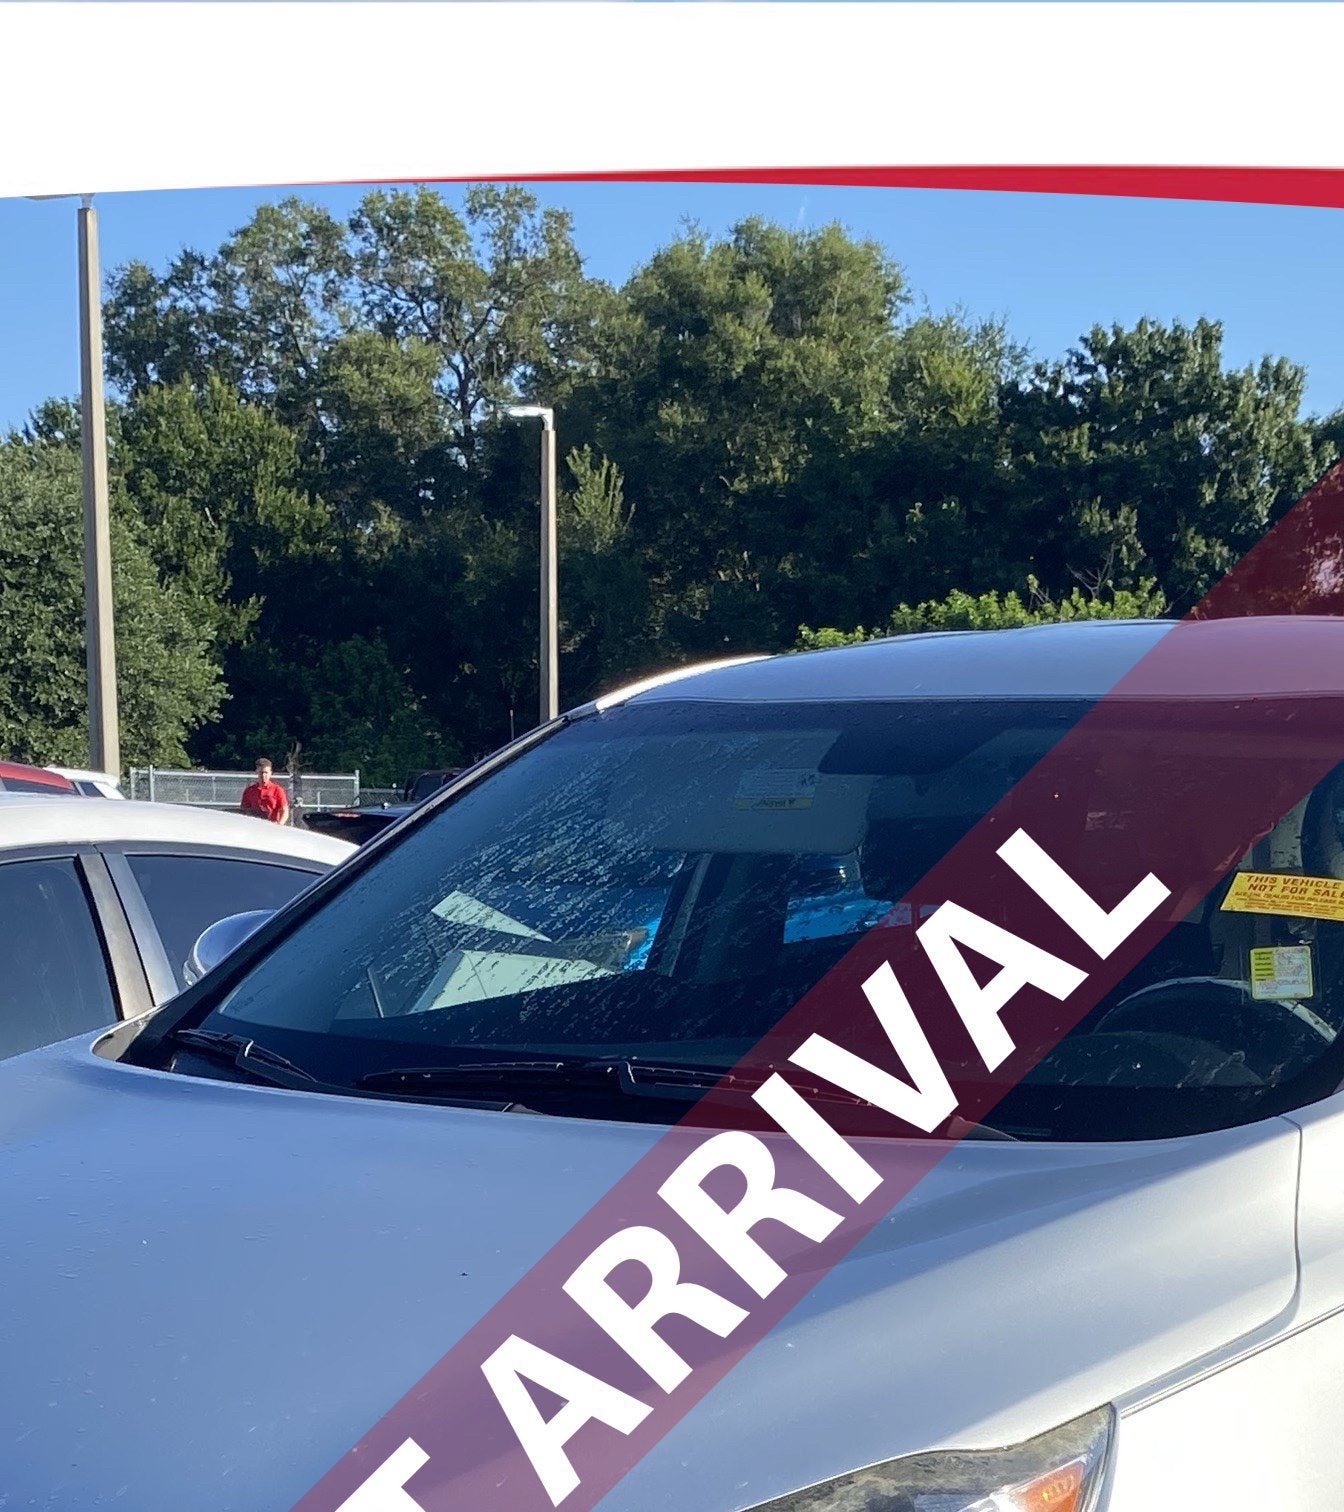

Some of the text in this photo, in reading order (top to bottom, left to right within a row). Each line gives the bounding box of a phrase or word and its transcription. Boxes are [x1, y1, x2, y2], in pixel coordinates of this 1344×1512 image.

[1246, 875, 1278, 884] THIS
[1283, 877, 1341, 890] VEHICLE
[1248, 883, 1276, 893] NOT
[1281, 886, 1309, 895] FOR
